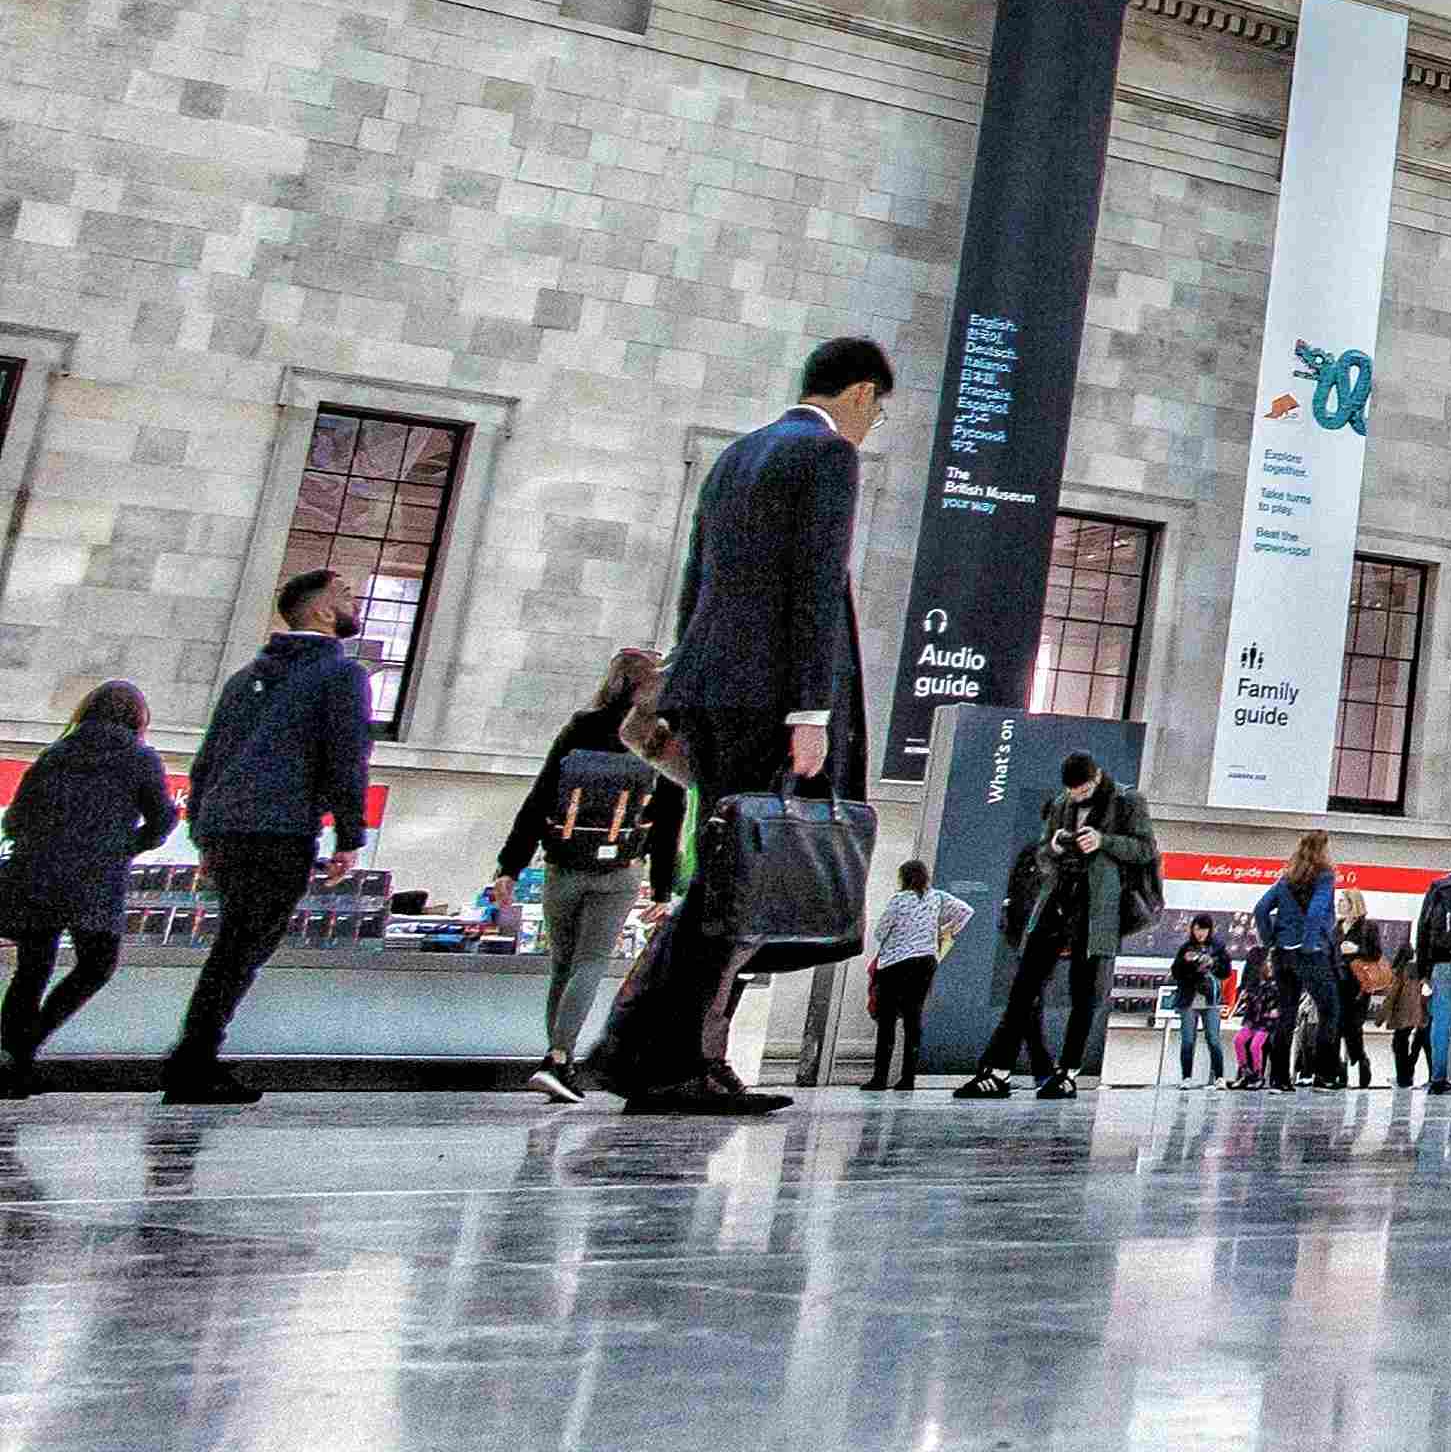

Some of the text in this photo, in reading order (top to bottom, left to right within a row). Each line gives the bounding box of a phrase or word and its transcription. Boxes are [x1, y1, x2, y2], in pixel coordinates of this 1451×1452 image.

[1264, 448, 1302, 465] Explore
[945, 466, 970, 482] The
[944, 481, 1036, 504] British Museum
[1261, 487, 1311, 505] Take turns
[942, 498, 997, 515] your way
[1256, 526, 1280, 541] Beat
[917, 642, 987, 671] Audio
[913, 672, 980, 698] guide
[1237, 677, 1300, 706] Family
[1234, 705, 1289, 726] guide
[1000, 719, 1016, 741] on
[1200, 861, 1233, 877] Audio
[1233, 866, 1262, 880] guide
